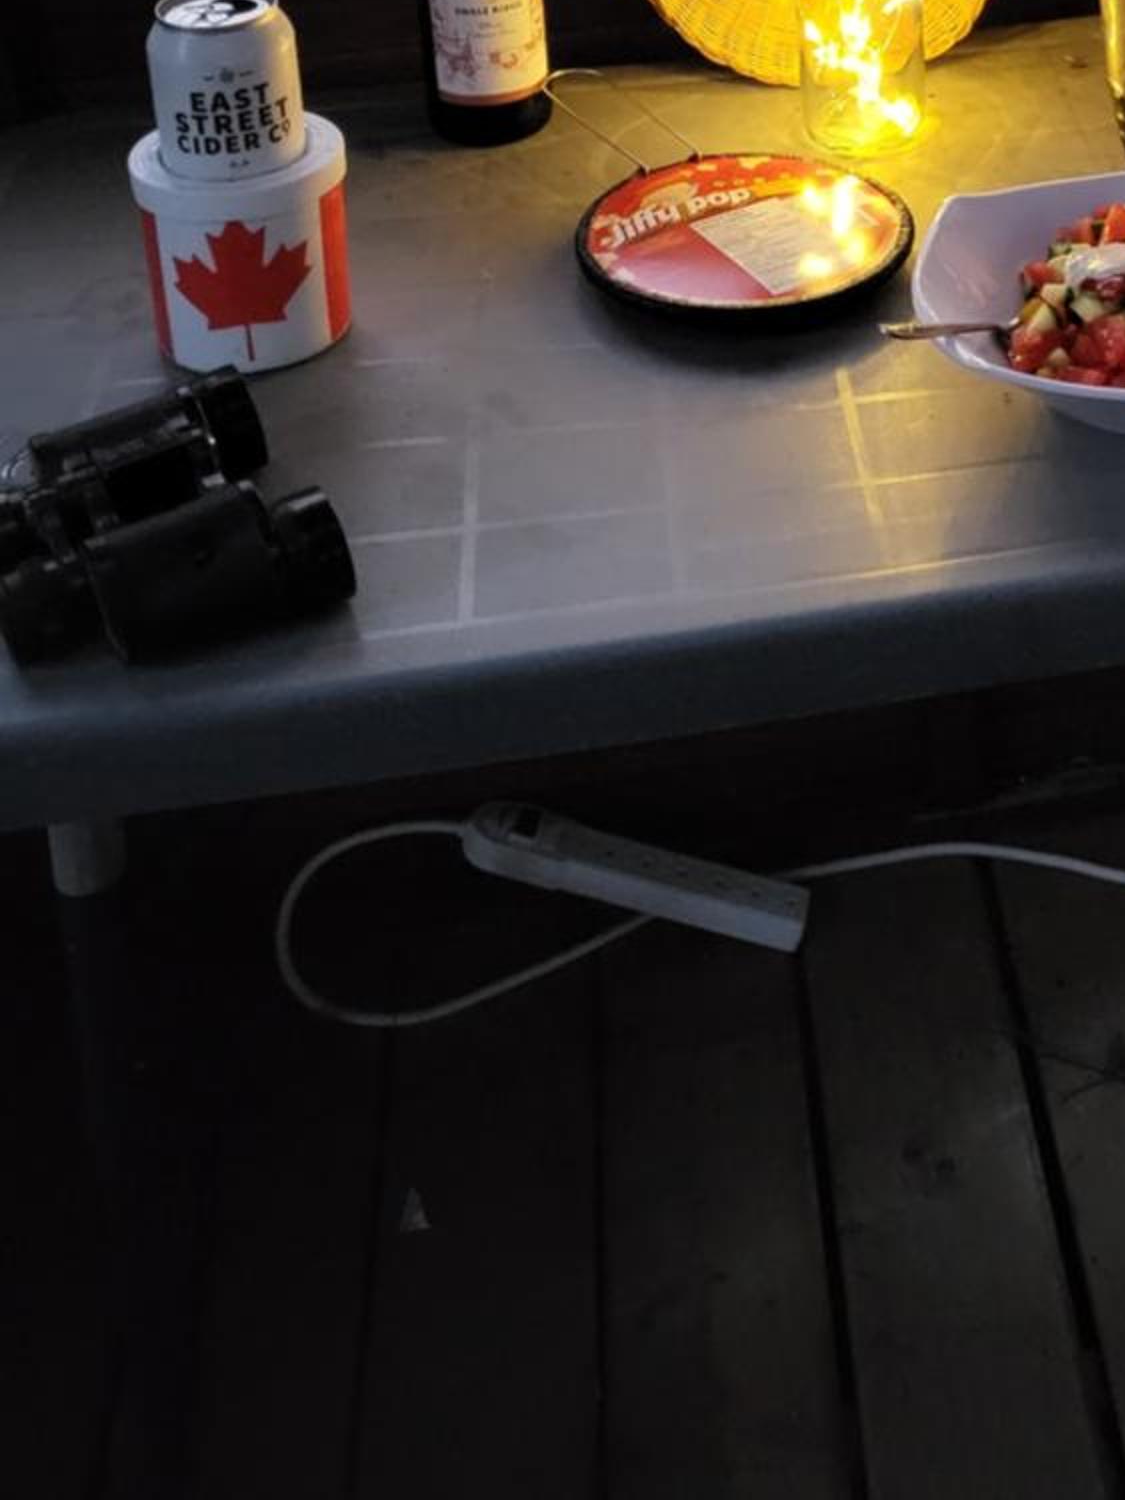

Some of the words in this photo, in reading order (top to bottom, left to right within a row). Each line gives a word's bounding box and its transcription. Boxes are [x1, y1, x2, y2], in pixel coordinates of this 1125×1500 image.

[190, 81, 269, 113] EAST
[176, 97, 288, 135] STREET
[177, 133, 261, 155] CIDER
[687, 188, 751, 217] pop
